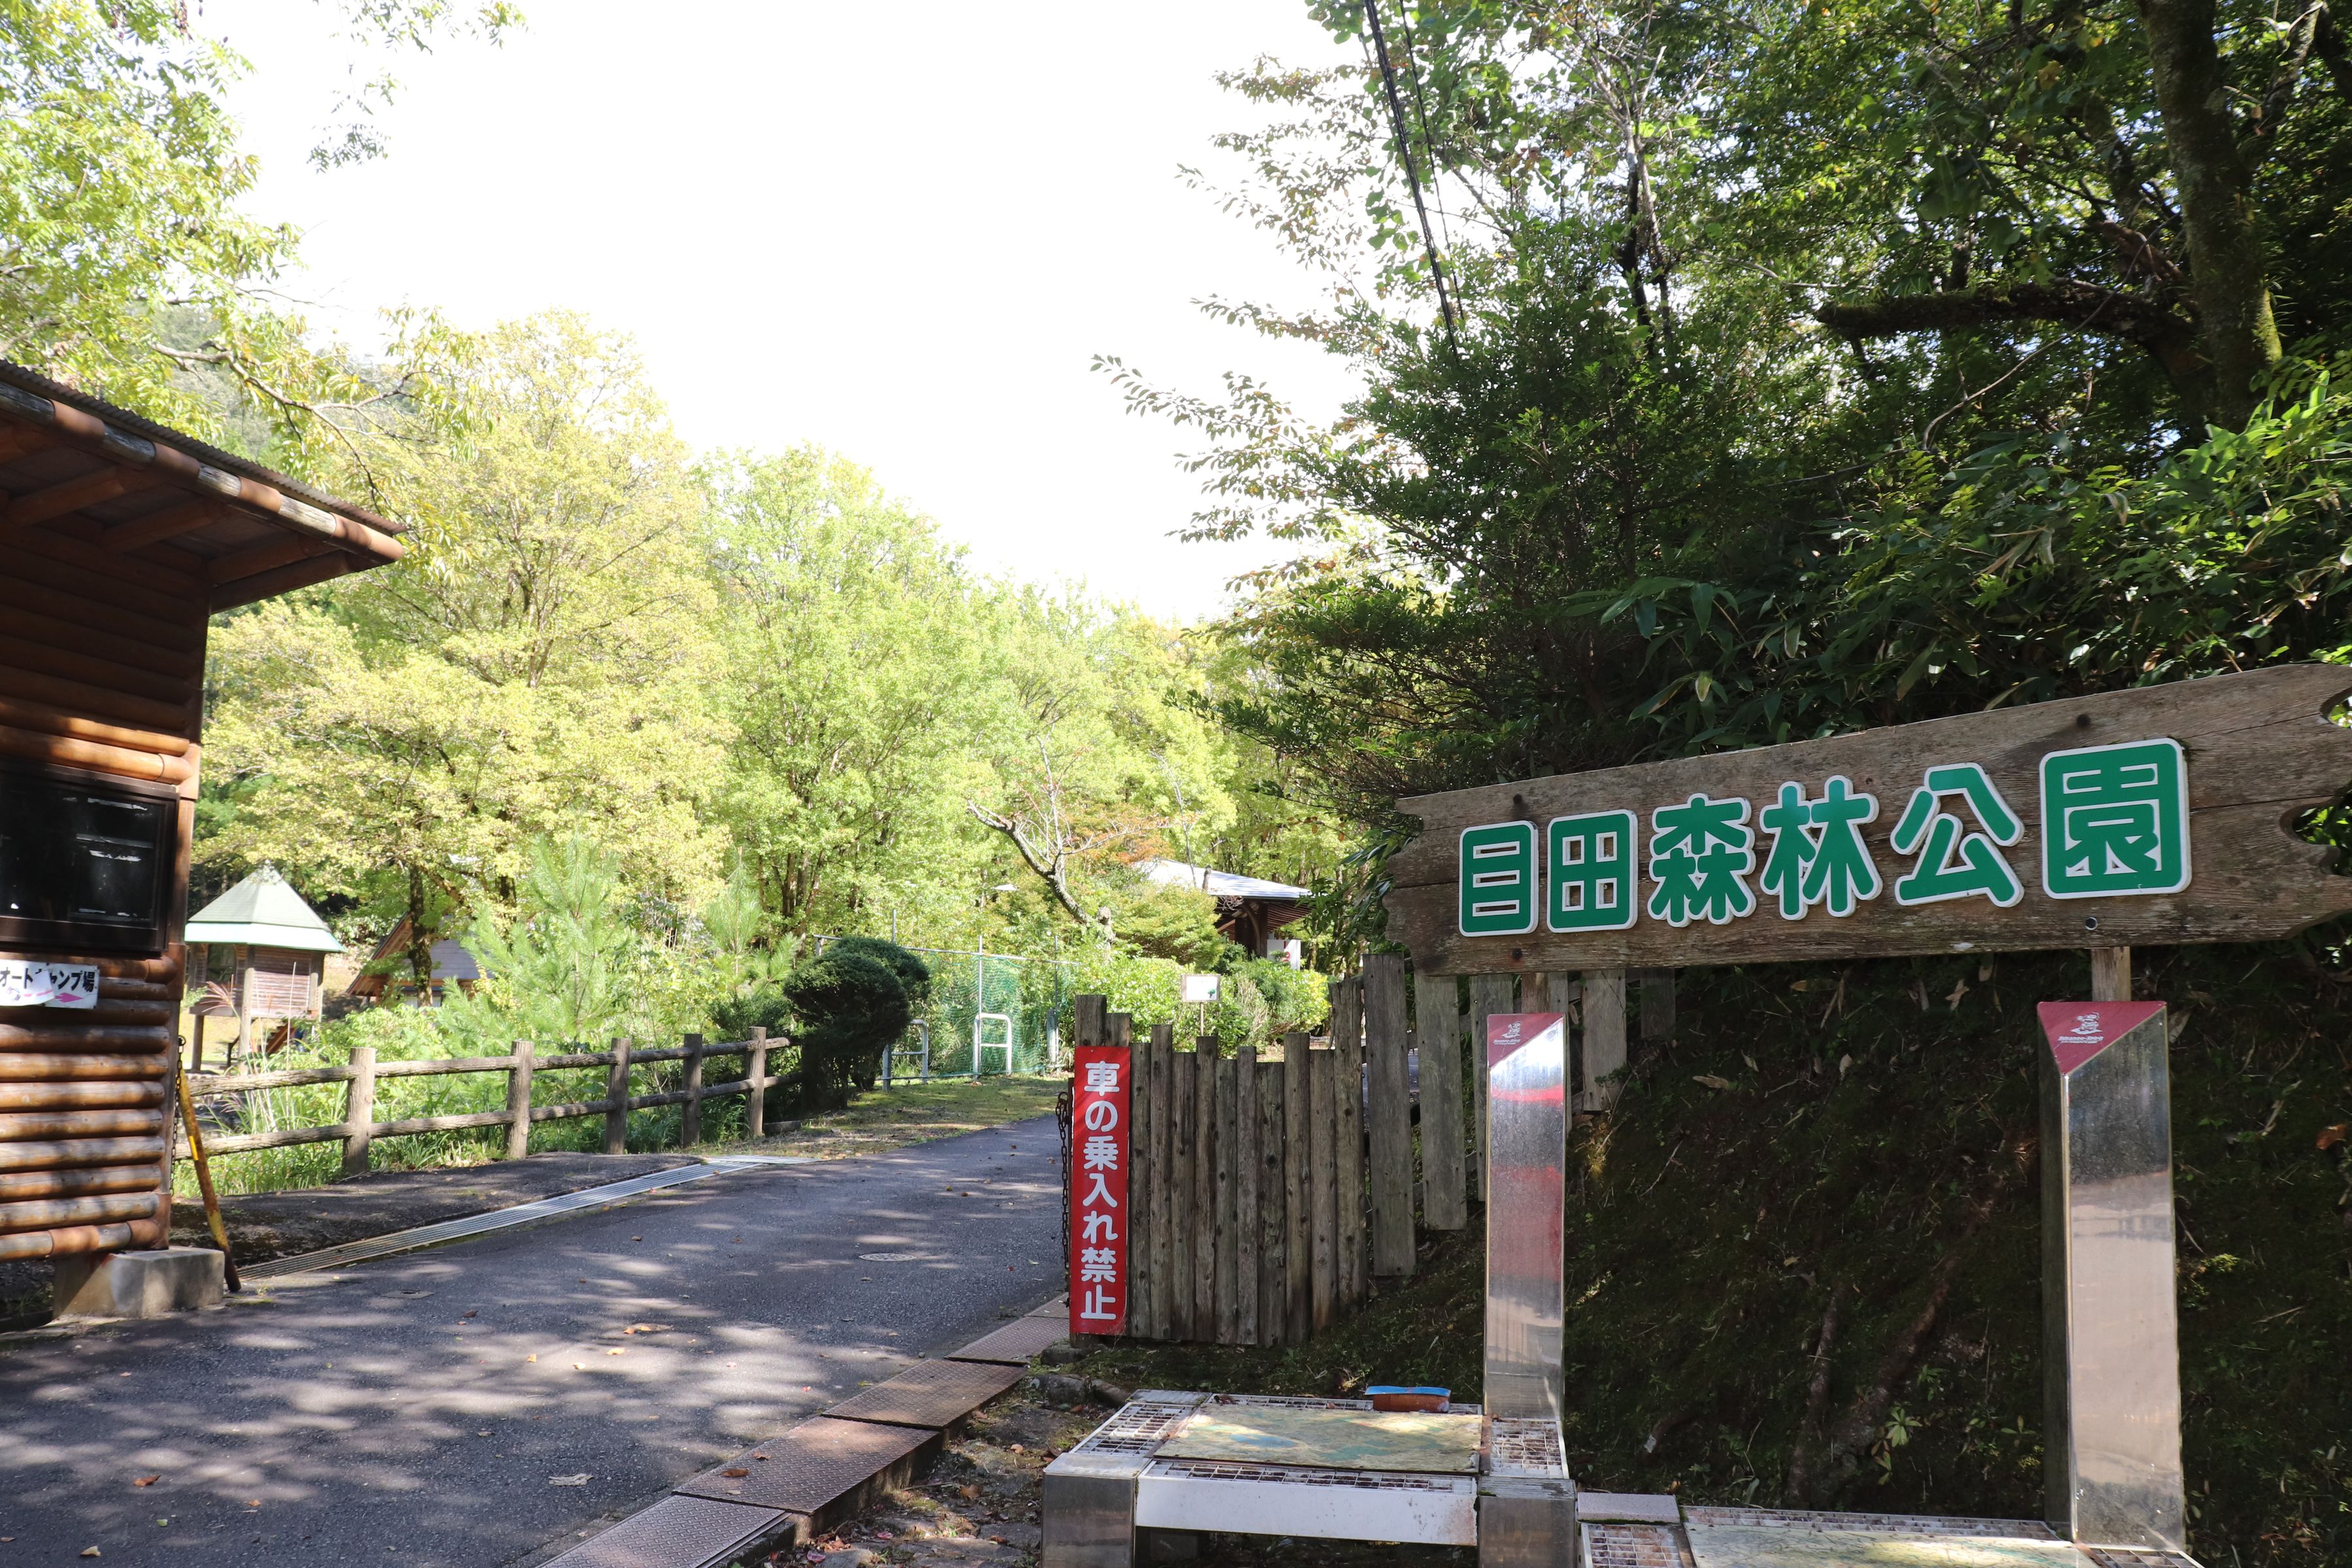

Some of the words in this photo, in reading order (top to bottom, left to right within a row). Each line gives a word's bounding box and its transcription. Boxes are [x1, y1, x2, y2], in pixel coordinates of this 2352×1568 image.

[1459, 739, 2191, 937] 目田森林公園
[0, 968, 95, 992] オートャンプ場
[1080, 1060, 1120, 1320] 車の乗入れ禁止
